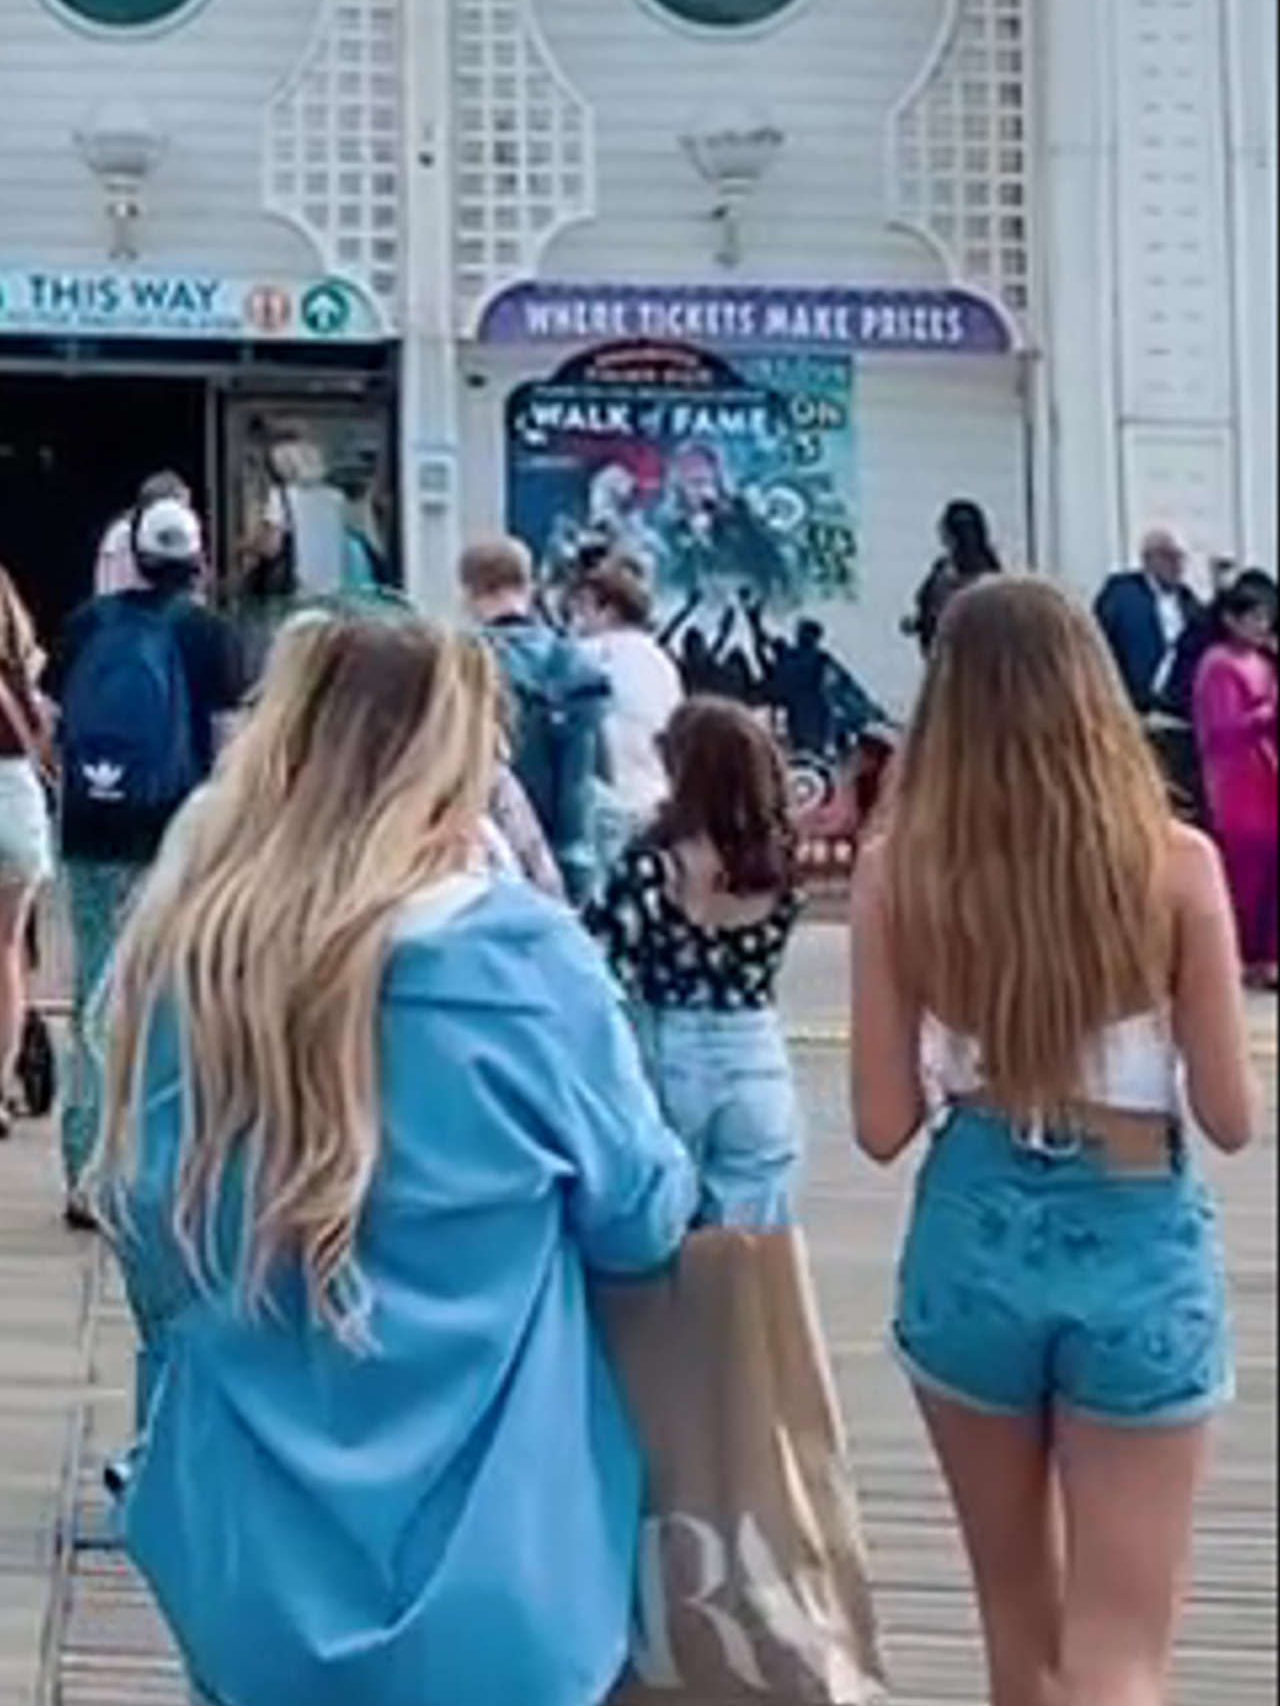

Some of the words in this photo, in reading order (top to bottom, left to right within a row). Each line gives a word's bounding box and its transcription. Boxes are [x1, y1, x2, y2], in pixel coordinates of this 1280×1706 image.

[29, 274, 120, 312] THIS
[129, 278, 221, 313] WAY
[523, 299, 627, 335] WHERE
[640, 300, 757, 337] TICKETS
[764, 303, 849, 340] MAKE
[860, 305, 964, 342] PRIZES
[530, 400, 633, 435] WALK
[672, 404, 769, 436] FAME
